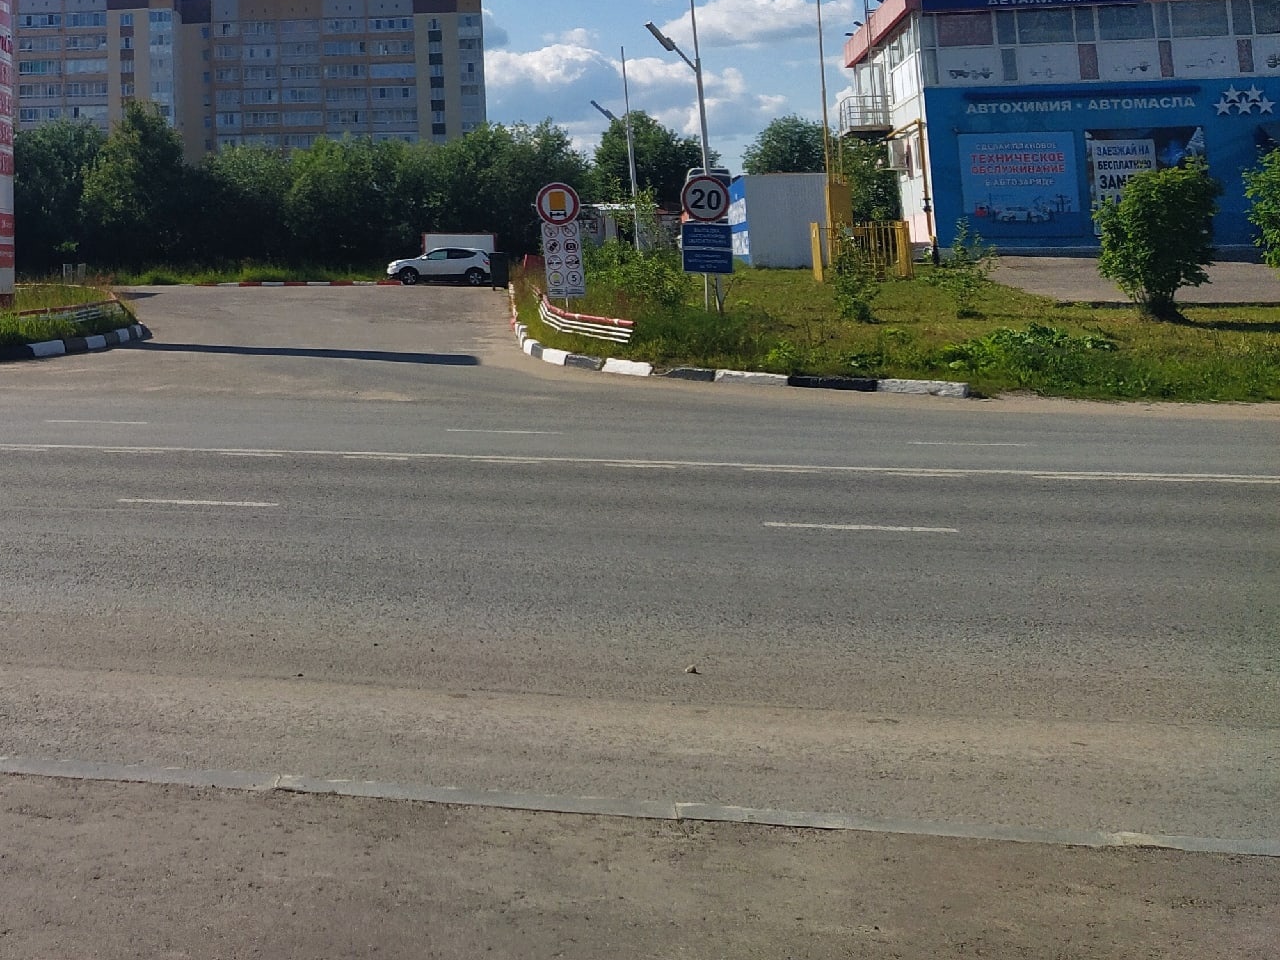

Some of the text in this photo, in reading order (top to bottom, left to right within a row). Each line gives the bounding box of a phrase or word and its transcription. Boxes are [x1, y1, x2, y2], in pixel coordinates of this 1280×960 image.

[966, 96, 1196, 115] АВТОХИМИЯ АВТОМАСЛА
[1096, 143, 1150, 156] ЗАЕЗЖАЙ НА
[971, 152, 1065, 164] ТЕХНИЧЕСКОЕ
[971, 164, 1065, 175] ОБСЛУЖИВАНИЕ
[690, 188, 721, 211] 20
[571, 274, 578, 282] 5
